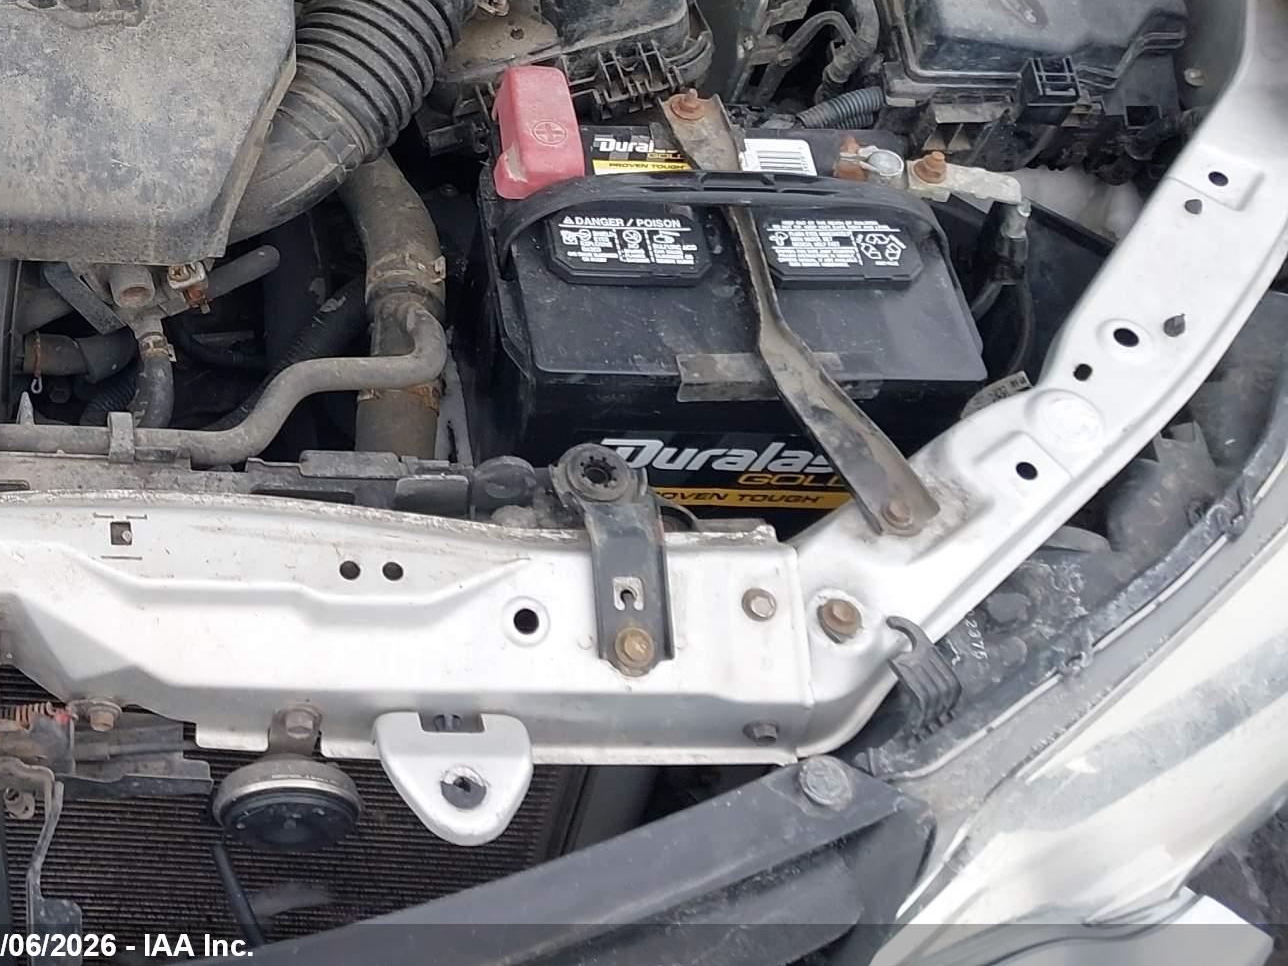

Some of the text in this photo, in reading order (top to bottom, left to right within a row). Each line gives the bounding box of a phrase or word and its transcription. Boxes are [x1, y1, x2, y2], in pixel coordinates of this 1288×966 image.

[594, 137, 678, 153] Dural
[608, 162, 648, 170] PROVEN
[574, 217, 624, 227] DANGER
[636, 218, 682, 228] POISON
[601, 438, 834, 474] Duralas
[738, 493, 824, 504] TOUGH
